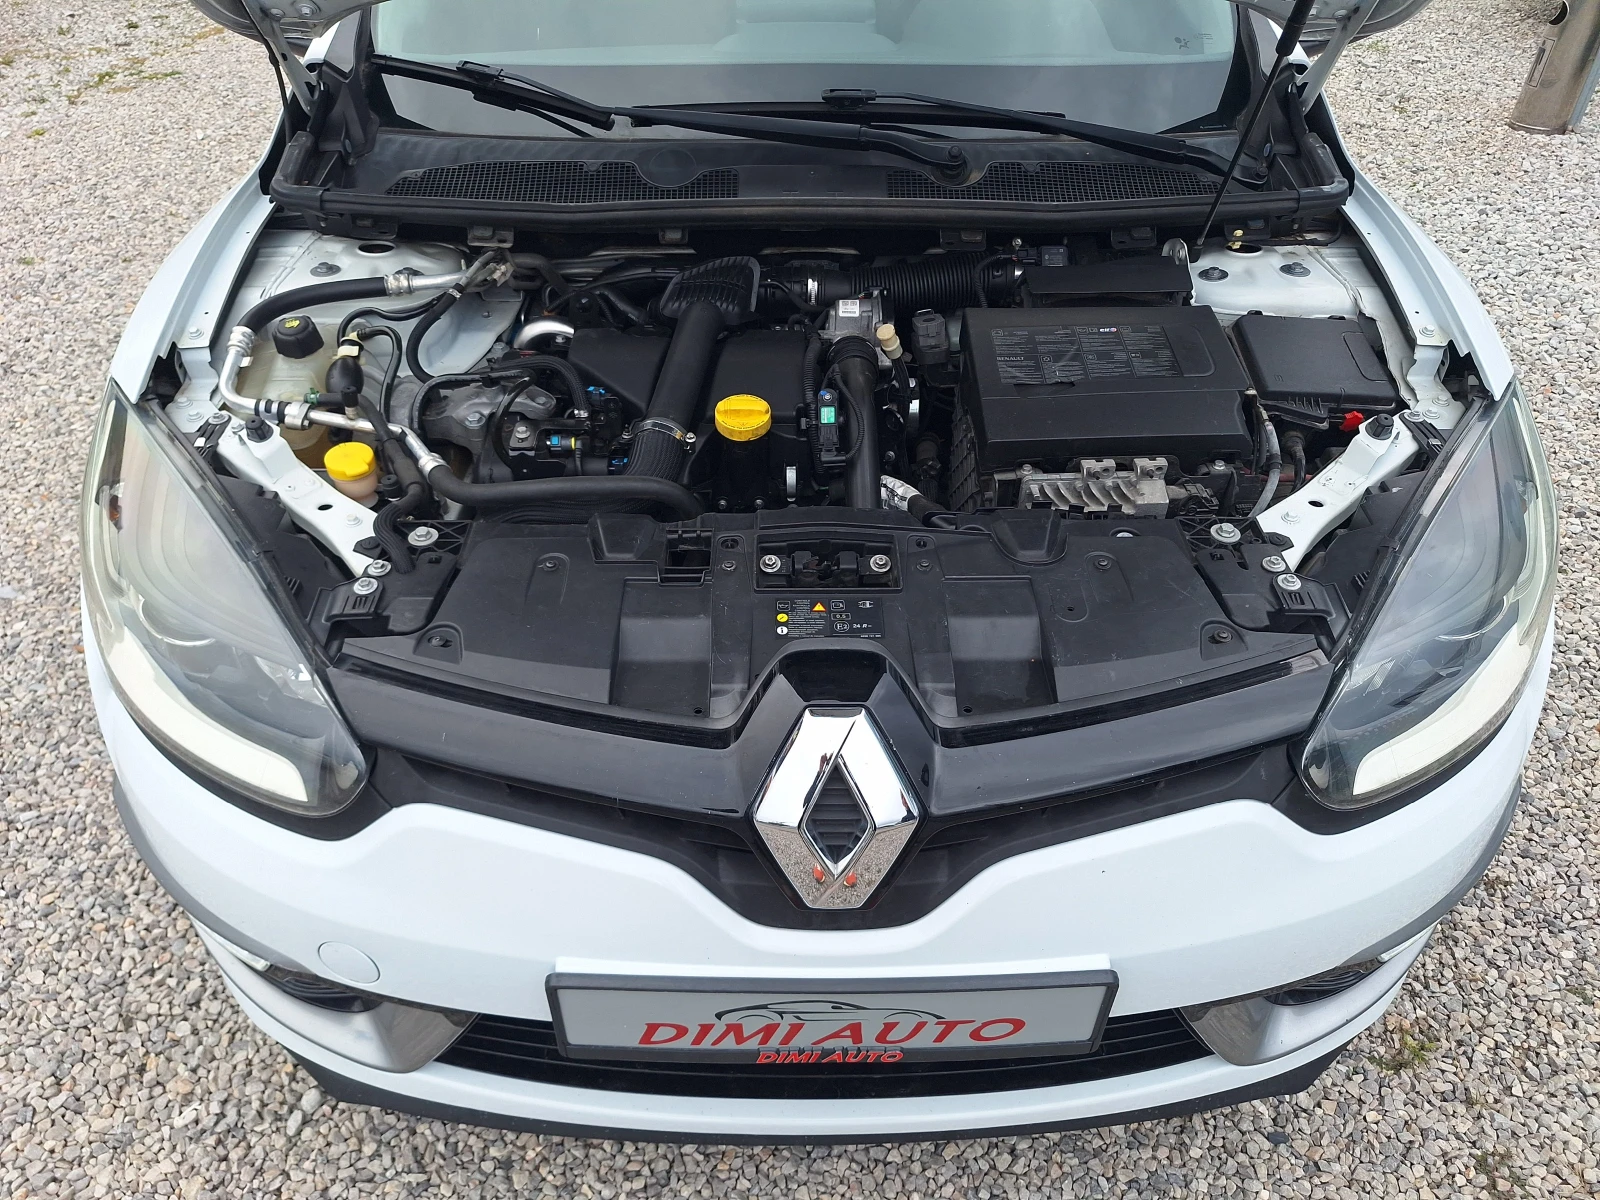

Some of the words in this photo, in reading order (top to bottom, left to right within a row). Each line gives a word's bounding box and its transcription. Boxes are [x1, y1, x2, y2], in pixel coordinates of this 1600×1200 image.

[639, 1023, 804, 1047] DIMI
[812, 1018, 1027, 1047] AUTO
[756, 1049, 822, 1065] DIMI
[821, 1049, 905, 1064] AUTO
